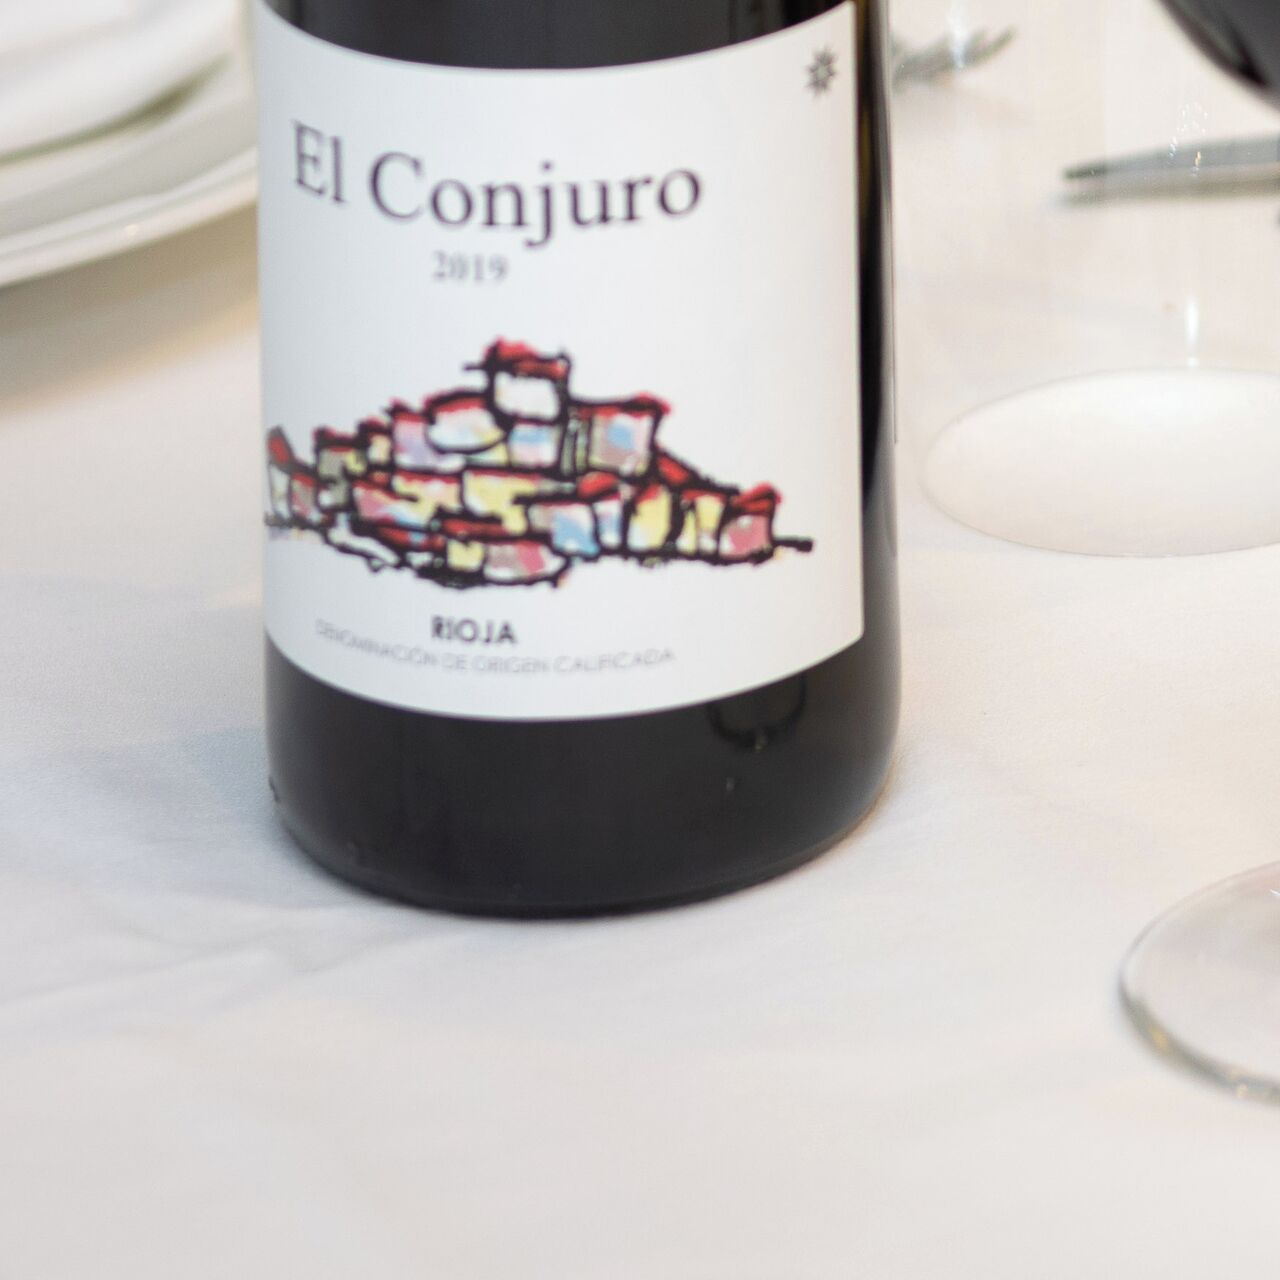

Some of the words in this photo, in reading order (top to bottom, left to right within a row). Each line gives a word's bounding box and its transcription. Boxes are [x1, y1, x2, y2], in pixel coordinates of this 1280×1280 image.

[294, 120, 345, 204] El
[369, 151, 702, 249] Conjuro
[432, 251, 507, 282] 2019
[431, 615, 517, 646] RIOJA
[442, 652, 467, 671] DE
[471, 654, 550, 673] ORIGEN
[554, 647, 675, 673] CALIFICADA
